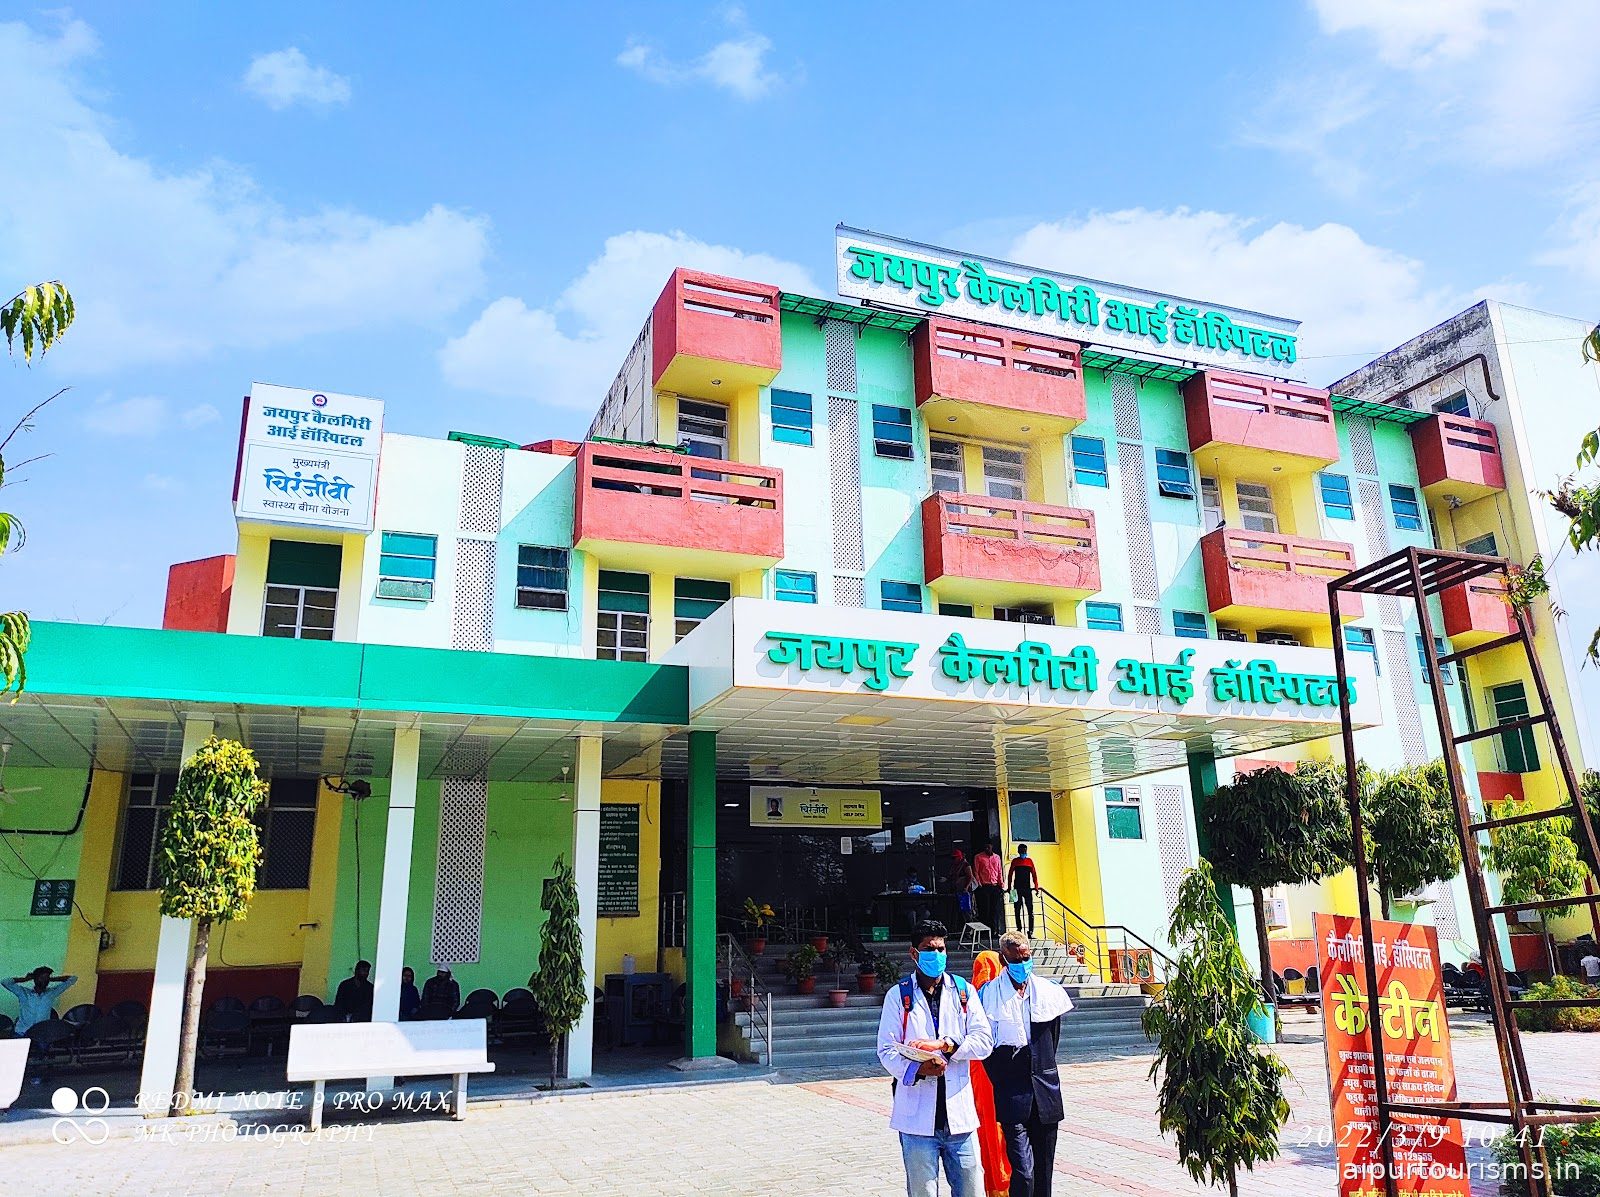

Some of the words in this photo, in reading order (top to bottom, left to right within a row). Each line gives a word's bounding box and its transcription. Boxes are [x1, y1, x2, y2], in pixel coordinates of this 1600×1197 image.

[847, 246, 961, 306] जयपुर
[961, 260, 1100, 327] कैलगिरी
[1105, 299, 1169, 344] आई
[1171, 305, 1298, 364] हॉस्पिटल
[263, 406, 310, 424] जयपुर
[311, 408, 373, 430] कैलगिरी
[267, 424, 298, 440] आई
[301, 427, 365, 447] हॉस्पिटल
[292, 457, 331, 470] मुख्यमंत्री
[263, 467, 356, 504] चिरंजीवी
[262, 499, 296, 511] स्वास्थ्य
[298, 501, 318, 513] बीमा
[321, 503, 349, 517] योजना
[765, 630, 920, 692] जयपुर
[938, 632, 1100, 692] कैलगिरी
[1116, 648, 1196, 706] आई
[1210, 658, 1358, 707] हॉस्पिटल
[1392, 938, 1432, 970] हॉस्पिटल
[1331, 973, 1440, 1042] कैटीन
